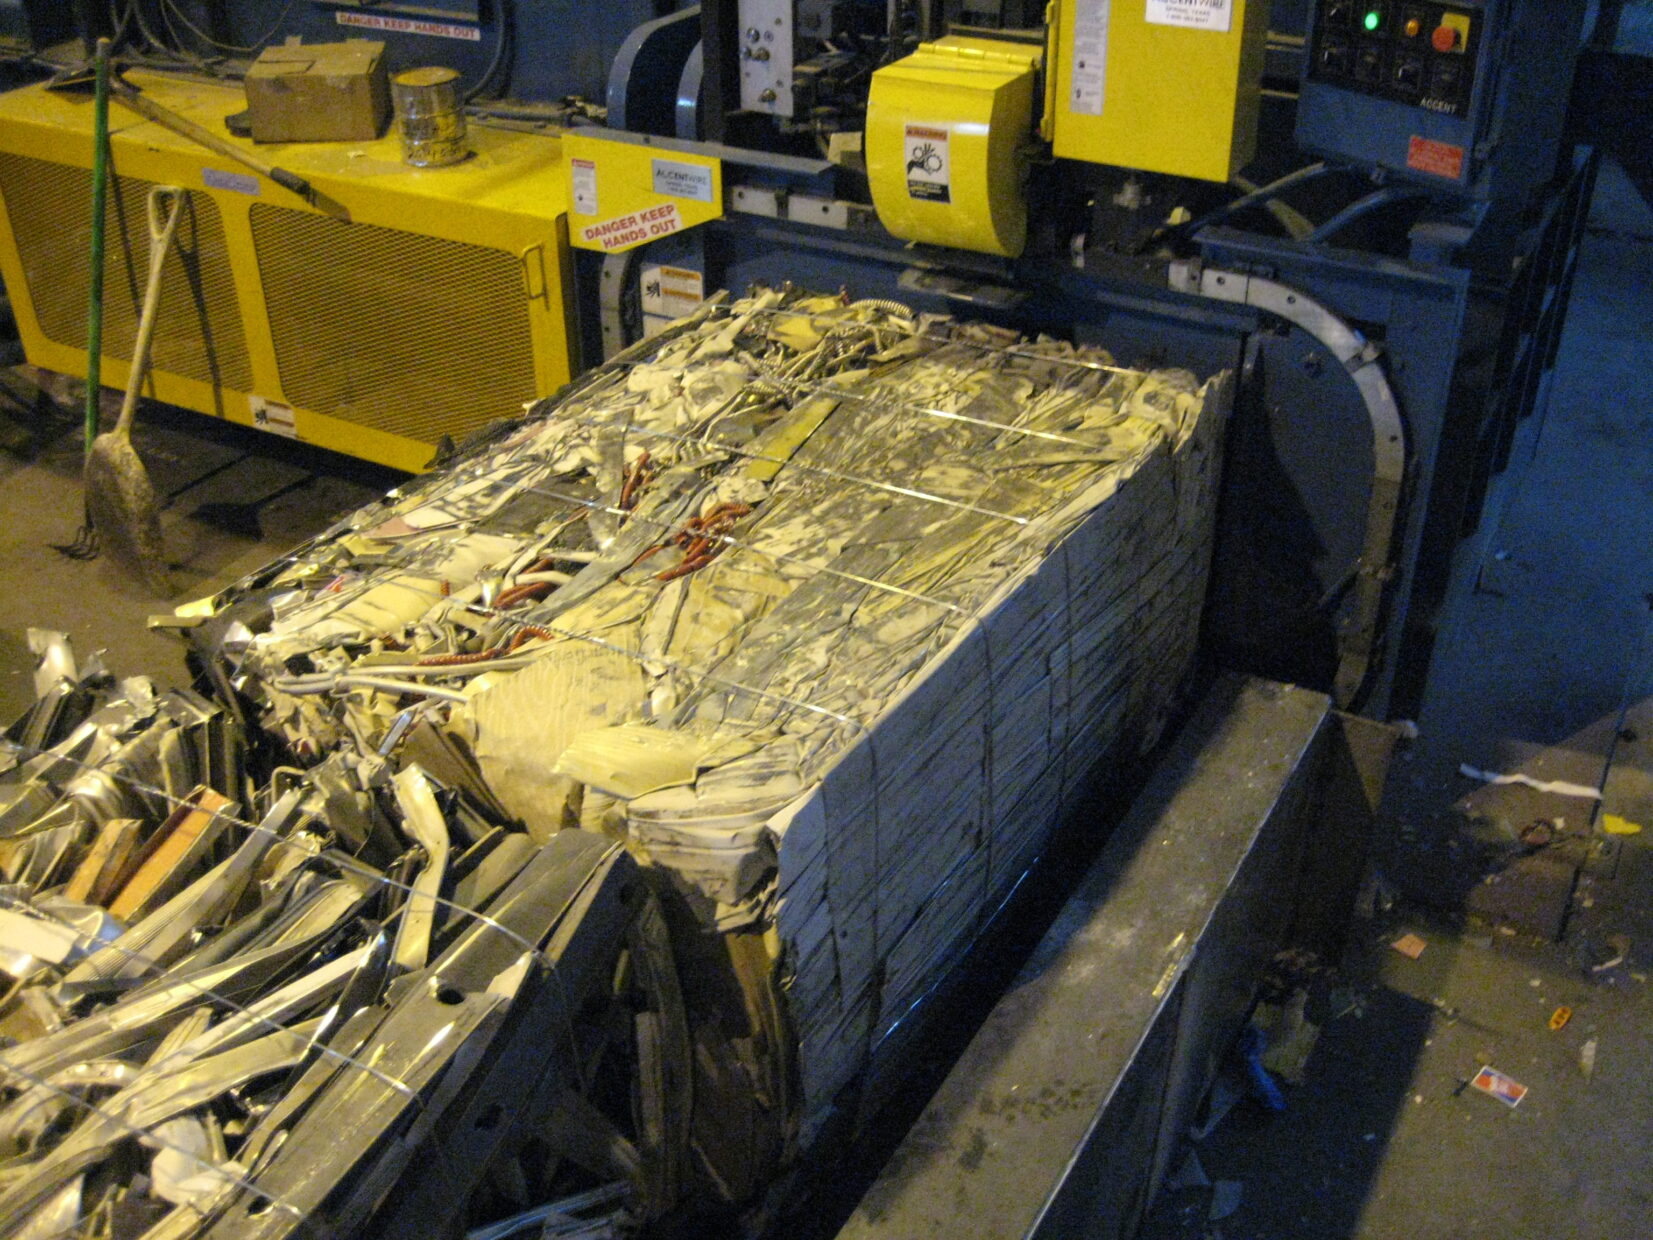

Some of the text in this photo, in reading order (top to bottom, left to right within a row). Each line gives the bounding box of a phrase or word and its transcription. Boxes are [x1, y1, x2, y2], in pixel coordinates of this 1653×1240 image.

[339, 13, 476, 38] DANGER KEEP HANDS OUT
[585, 204, 675, 240] DANGER KEEP
[603, 219, 676, 249] HANDS OUT
